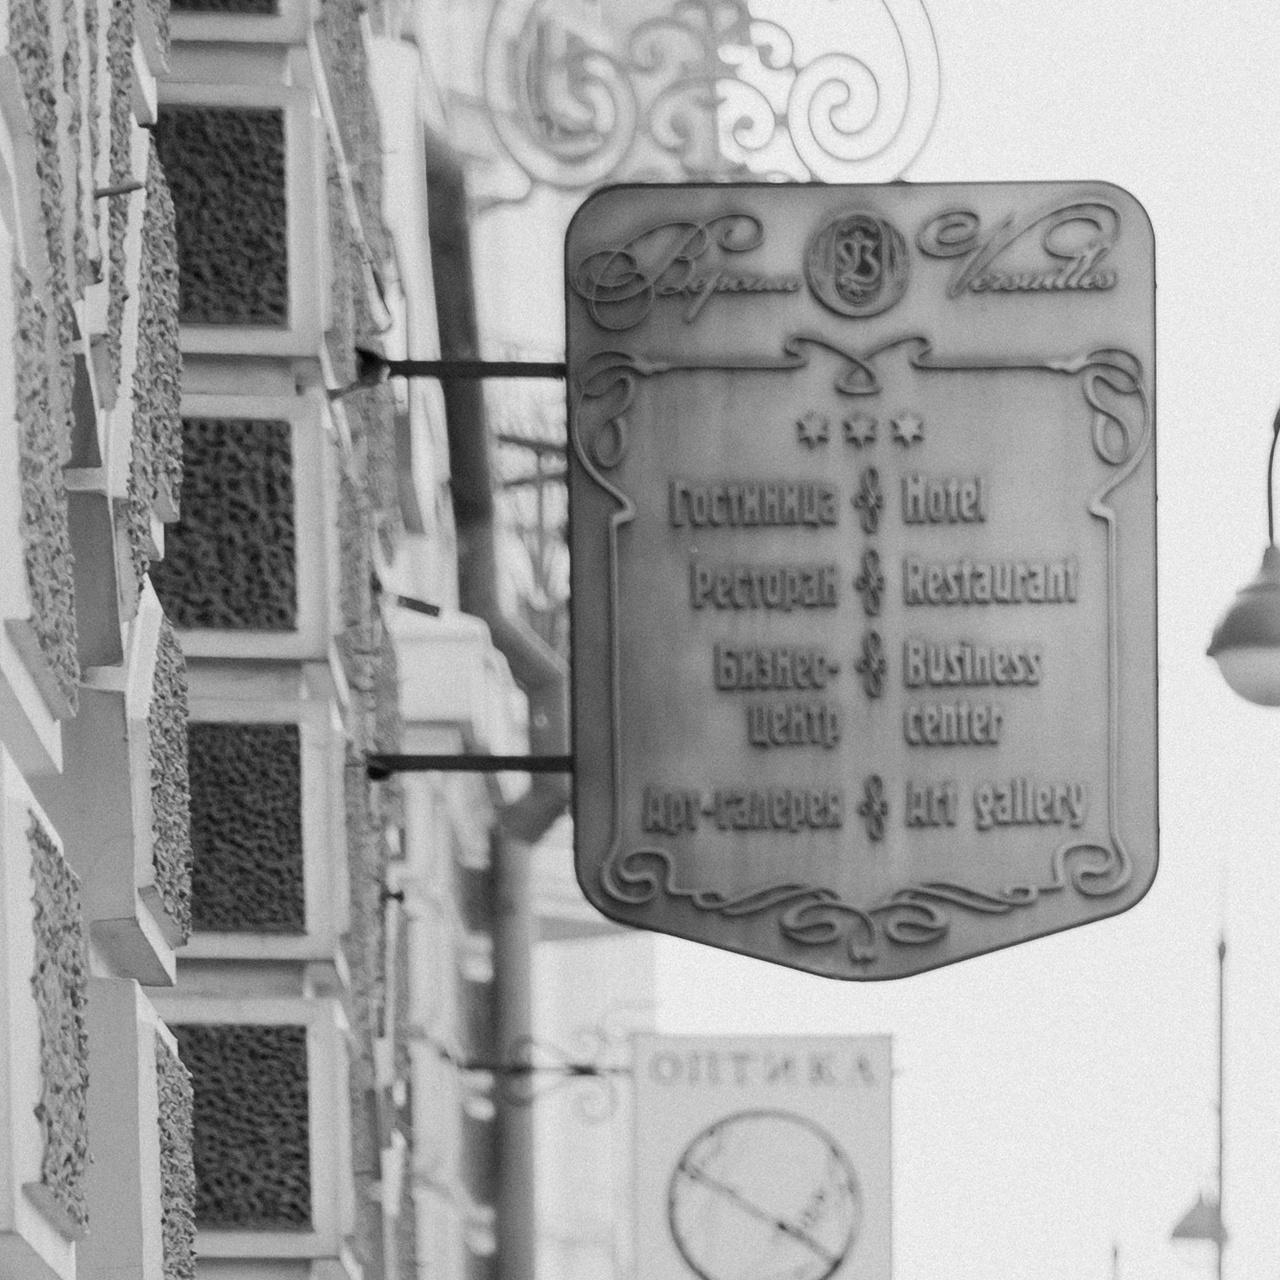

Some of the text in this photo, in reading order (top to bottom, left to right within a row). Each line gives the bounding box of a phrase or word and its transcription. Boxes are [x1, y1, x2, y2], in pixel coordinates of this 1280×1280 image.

[914, 202, 1122, 300] Versailles
[667, 478, 838, 528] Гостиница
[901, 473, 987, 523] Hotel
[689, 562, 837, 612] Ресторан
[901, 557, 1078, 605] Restaurant
[902, 638, 1041, 688] Business
[902, 701, 1003, 746] center
[904, 775, 1085, 834] Art gallery
[649, 1049, 877, 1087] ОПТИКА
